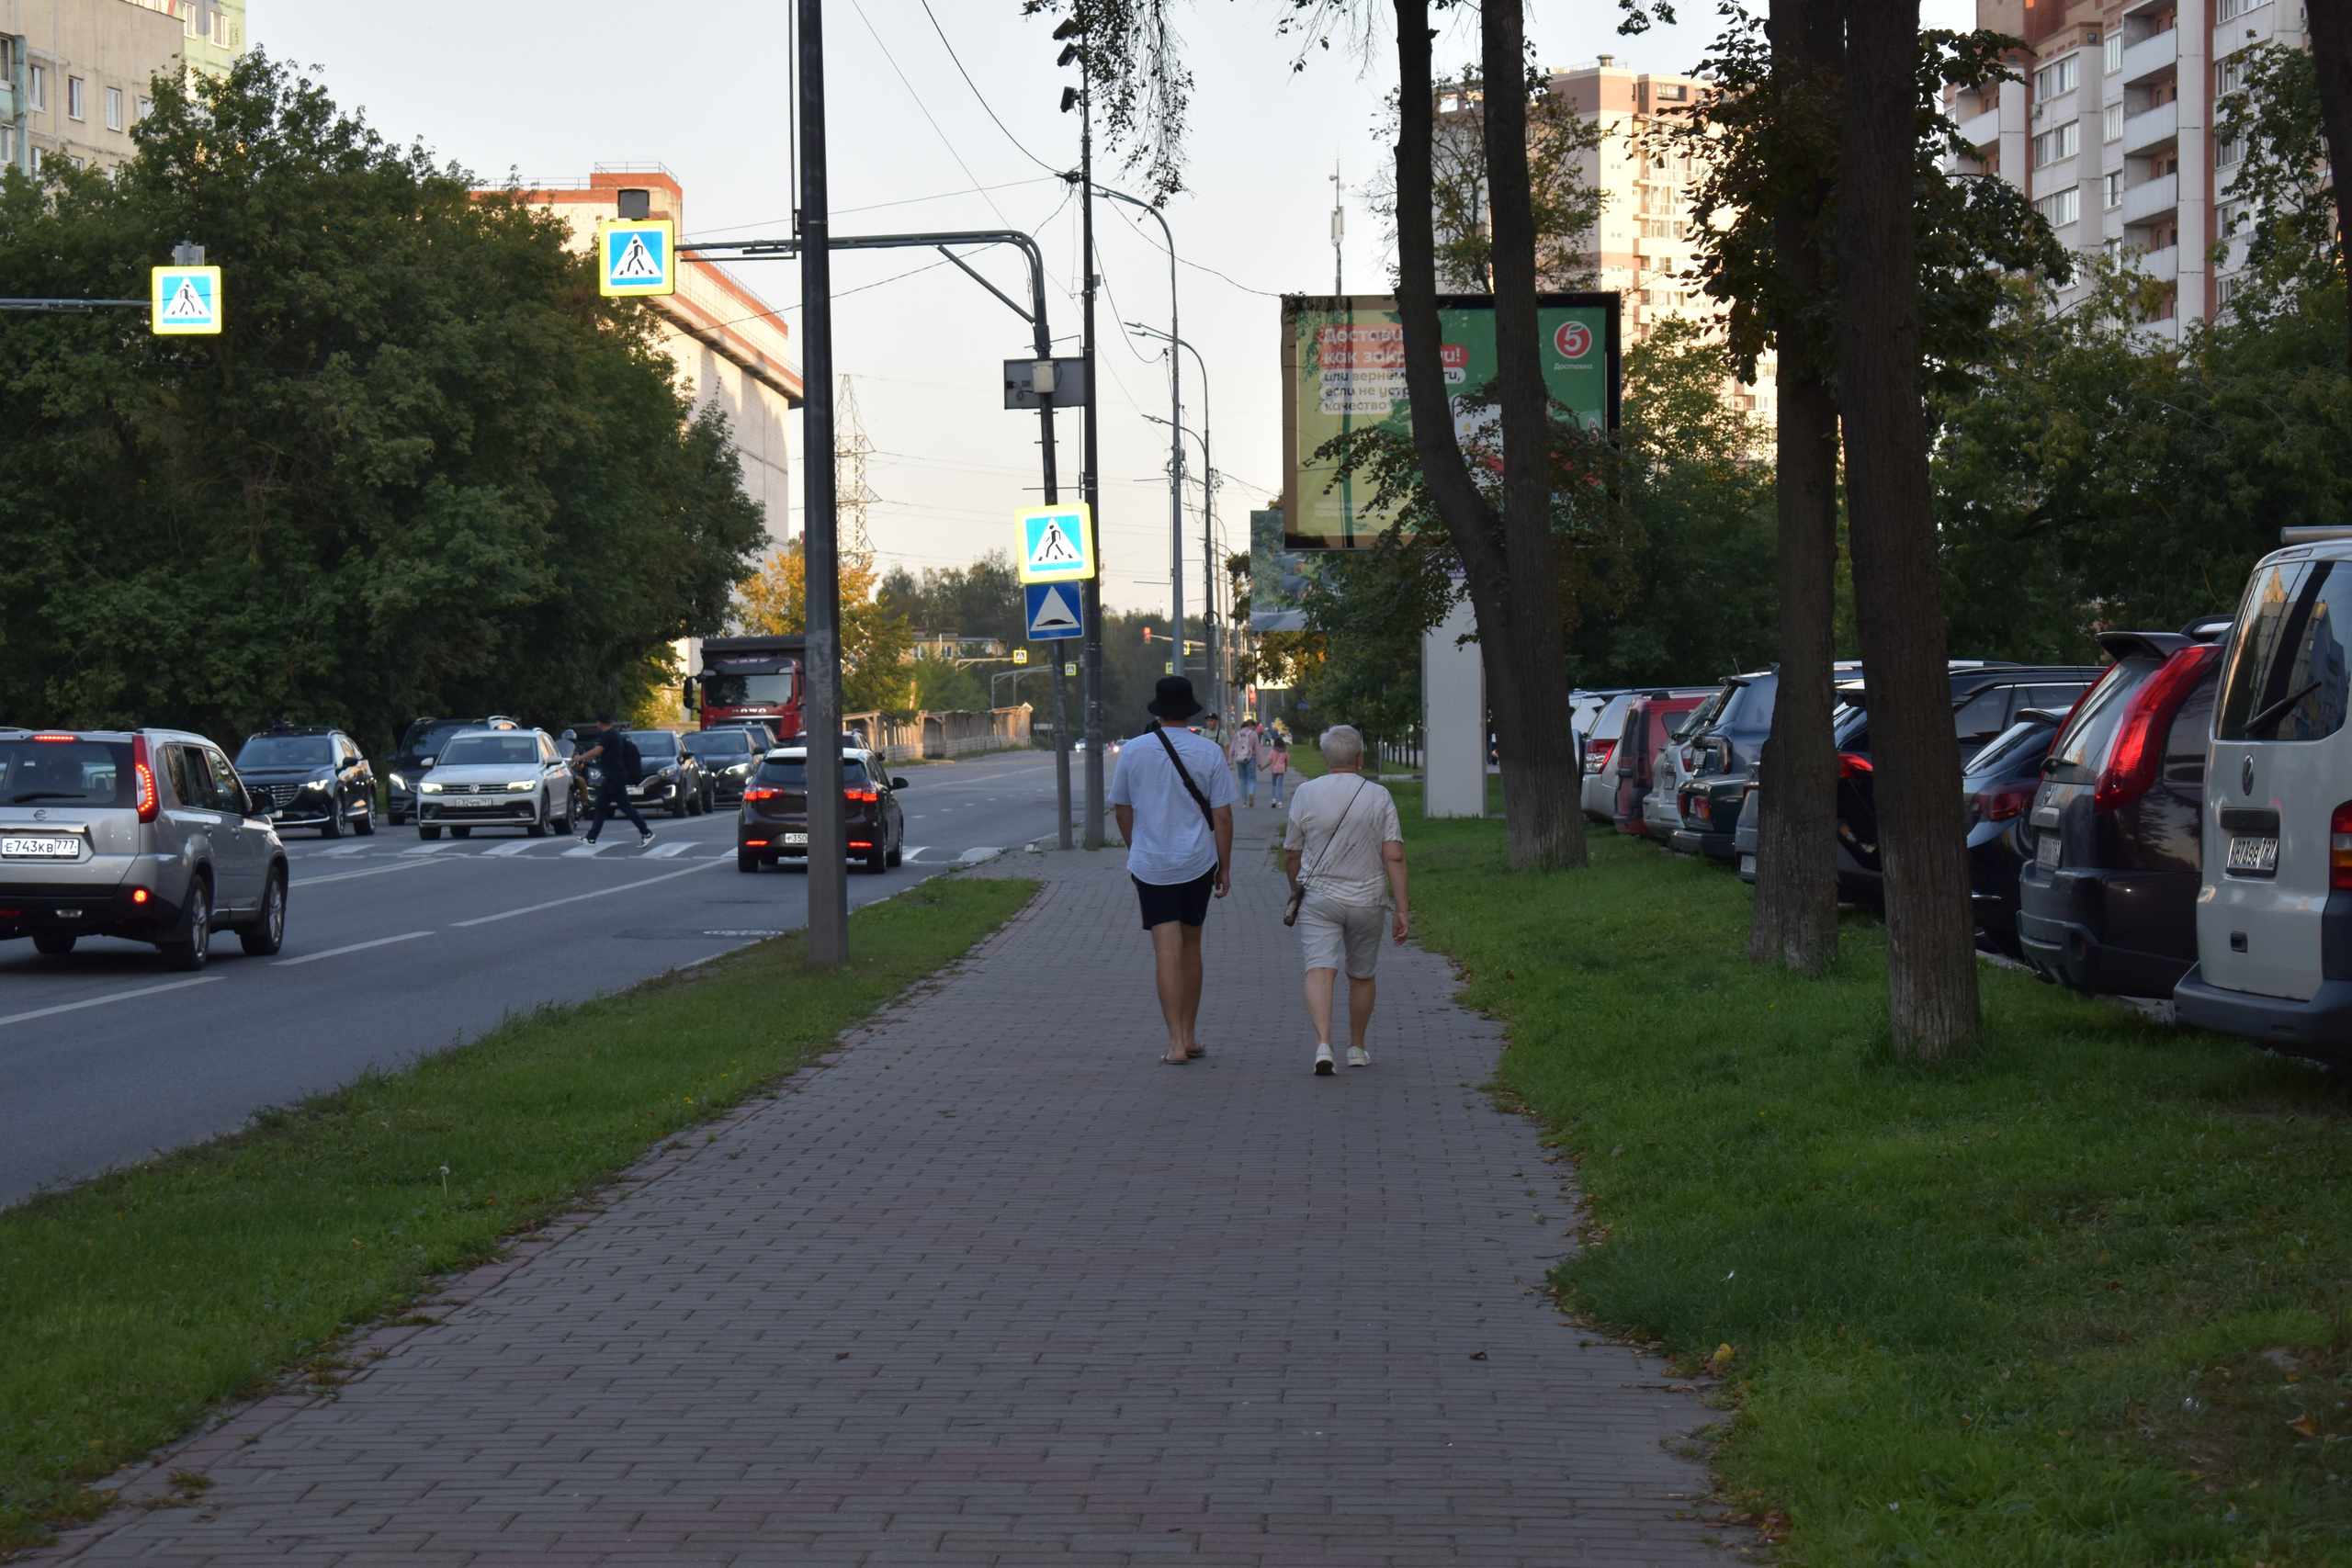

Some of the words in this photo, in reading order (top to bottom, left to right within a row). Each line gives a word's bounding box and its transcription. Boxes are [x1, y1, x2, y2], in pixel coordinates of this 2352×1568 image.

[1323, 328, 1404, 344] Достави
[1324, 351, 1357, 364] как
[1325, 372, 1349, 381] или
[1325, 387, 1355, 396] если
[1359, 387, 1375, 396] не
[1325, 401, 1387, 412] качество
[786, 834, 808, 842] Р350
